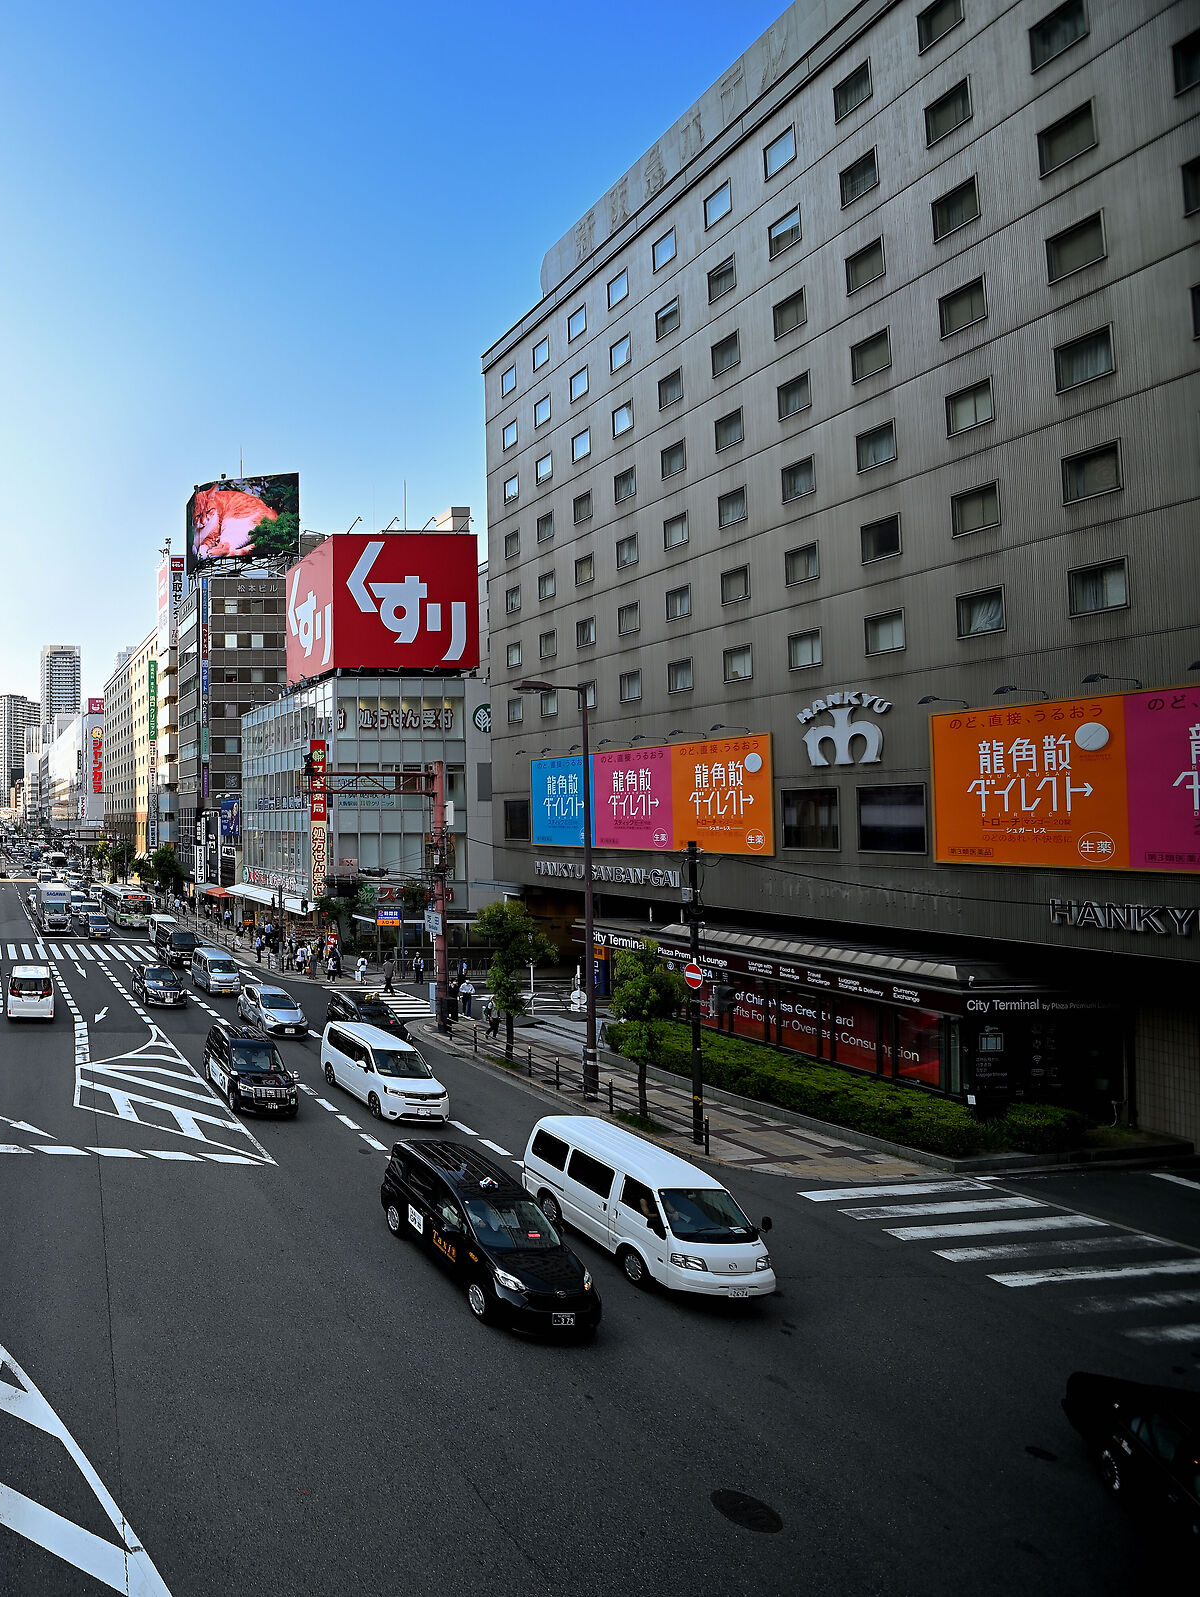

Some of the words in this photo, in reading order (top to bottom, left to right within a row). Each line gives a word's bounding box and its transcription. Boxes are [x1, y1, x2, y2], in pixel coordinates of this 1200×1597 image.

[237, 584, 278, 593] 松本ビル
[346, 541, 467, 661] くすり
[287, 568, 333, 666] くすり
[796, 691, 894, 726] HANKYU
[949, 703, 1104, 730] のど、直接、うるおう
[359, 708, 453, 730] 処方せん受付
[680, 740, 760, 756] のど、直接、うるおう
[978, 733, 1073, 775] 龍角散
[92, 739, 103, 793] ジャンカラ
[694, 760, 744, 788] 龍角散
[612, 767, 652, 793] 龍角散
[980, 771, 1071, 780] RYUKAKUSAN
[546, 774, 578, 795] 龍角散
[688, 790, 755, 816] ダイレクト
[966, 776, 1094, 813] ダイレクト
[543, 796, 585, 817] ダイレクト
[608, 794, 660, 817] ダイレクト
[982, 817, 1021, 827] トローチ
[1006, 826, 1047, 834] シュガーレス
[654, 833, 667, 841] 生薬
[747, 835, 765, 844] 生薬
[1080, 840, 1113, 854] 生薬
[312, 827, 327, 896] 処方せん受付
[534, 860, 585, 879] HANKYU
[1049, 898, 1200, 936] HANKY
[607, 934, 648, 950] Terminal
[657, 946, 675, 958] Plaza
[702, 955, 728, 968] Lounge
[780, 971, 800, 980] Beverage
[807, 970, 821, 979] Travel
[807, 976, 831, 986] Concierge
[838, 976, 860, 986] Luggage
[735, 991, 745, 1000] of
[838, 982, 858, 992] Storage
[863, 987, 884, 997] Delivery
[893, 986, 919, 997] Currency
[893, 992, 920, 1003] Exchange
[966, 999, 990, 1013] City
[992, 998, 1040, 1011] Terminal
[1042, 1002, 1050, 1011] by
[1051, 1002, 1068, 1010] Plaza
